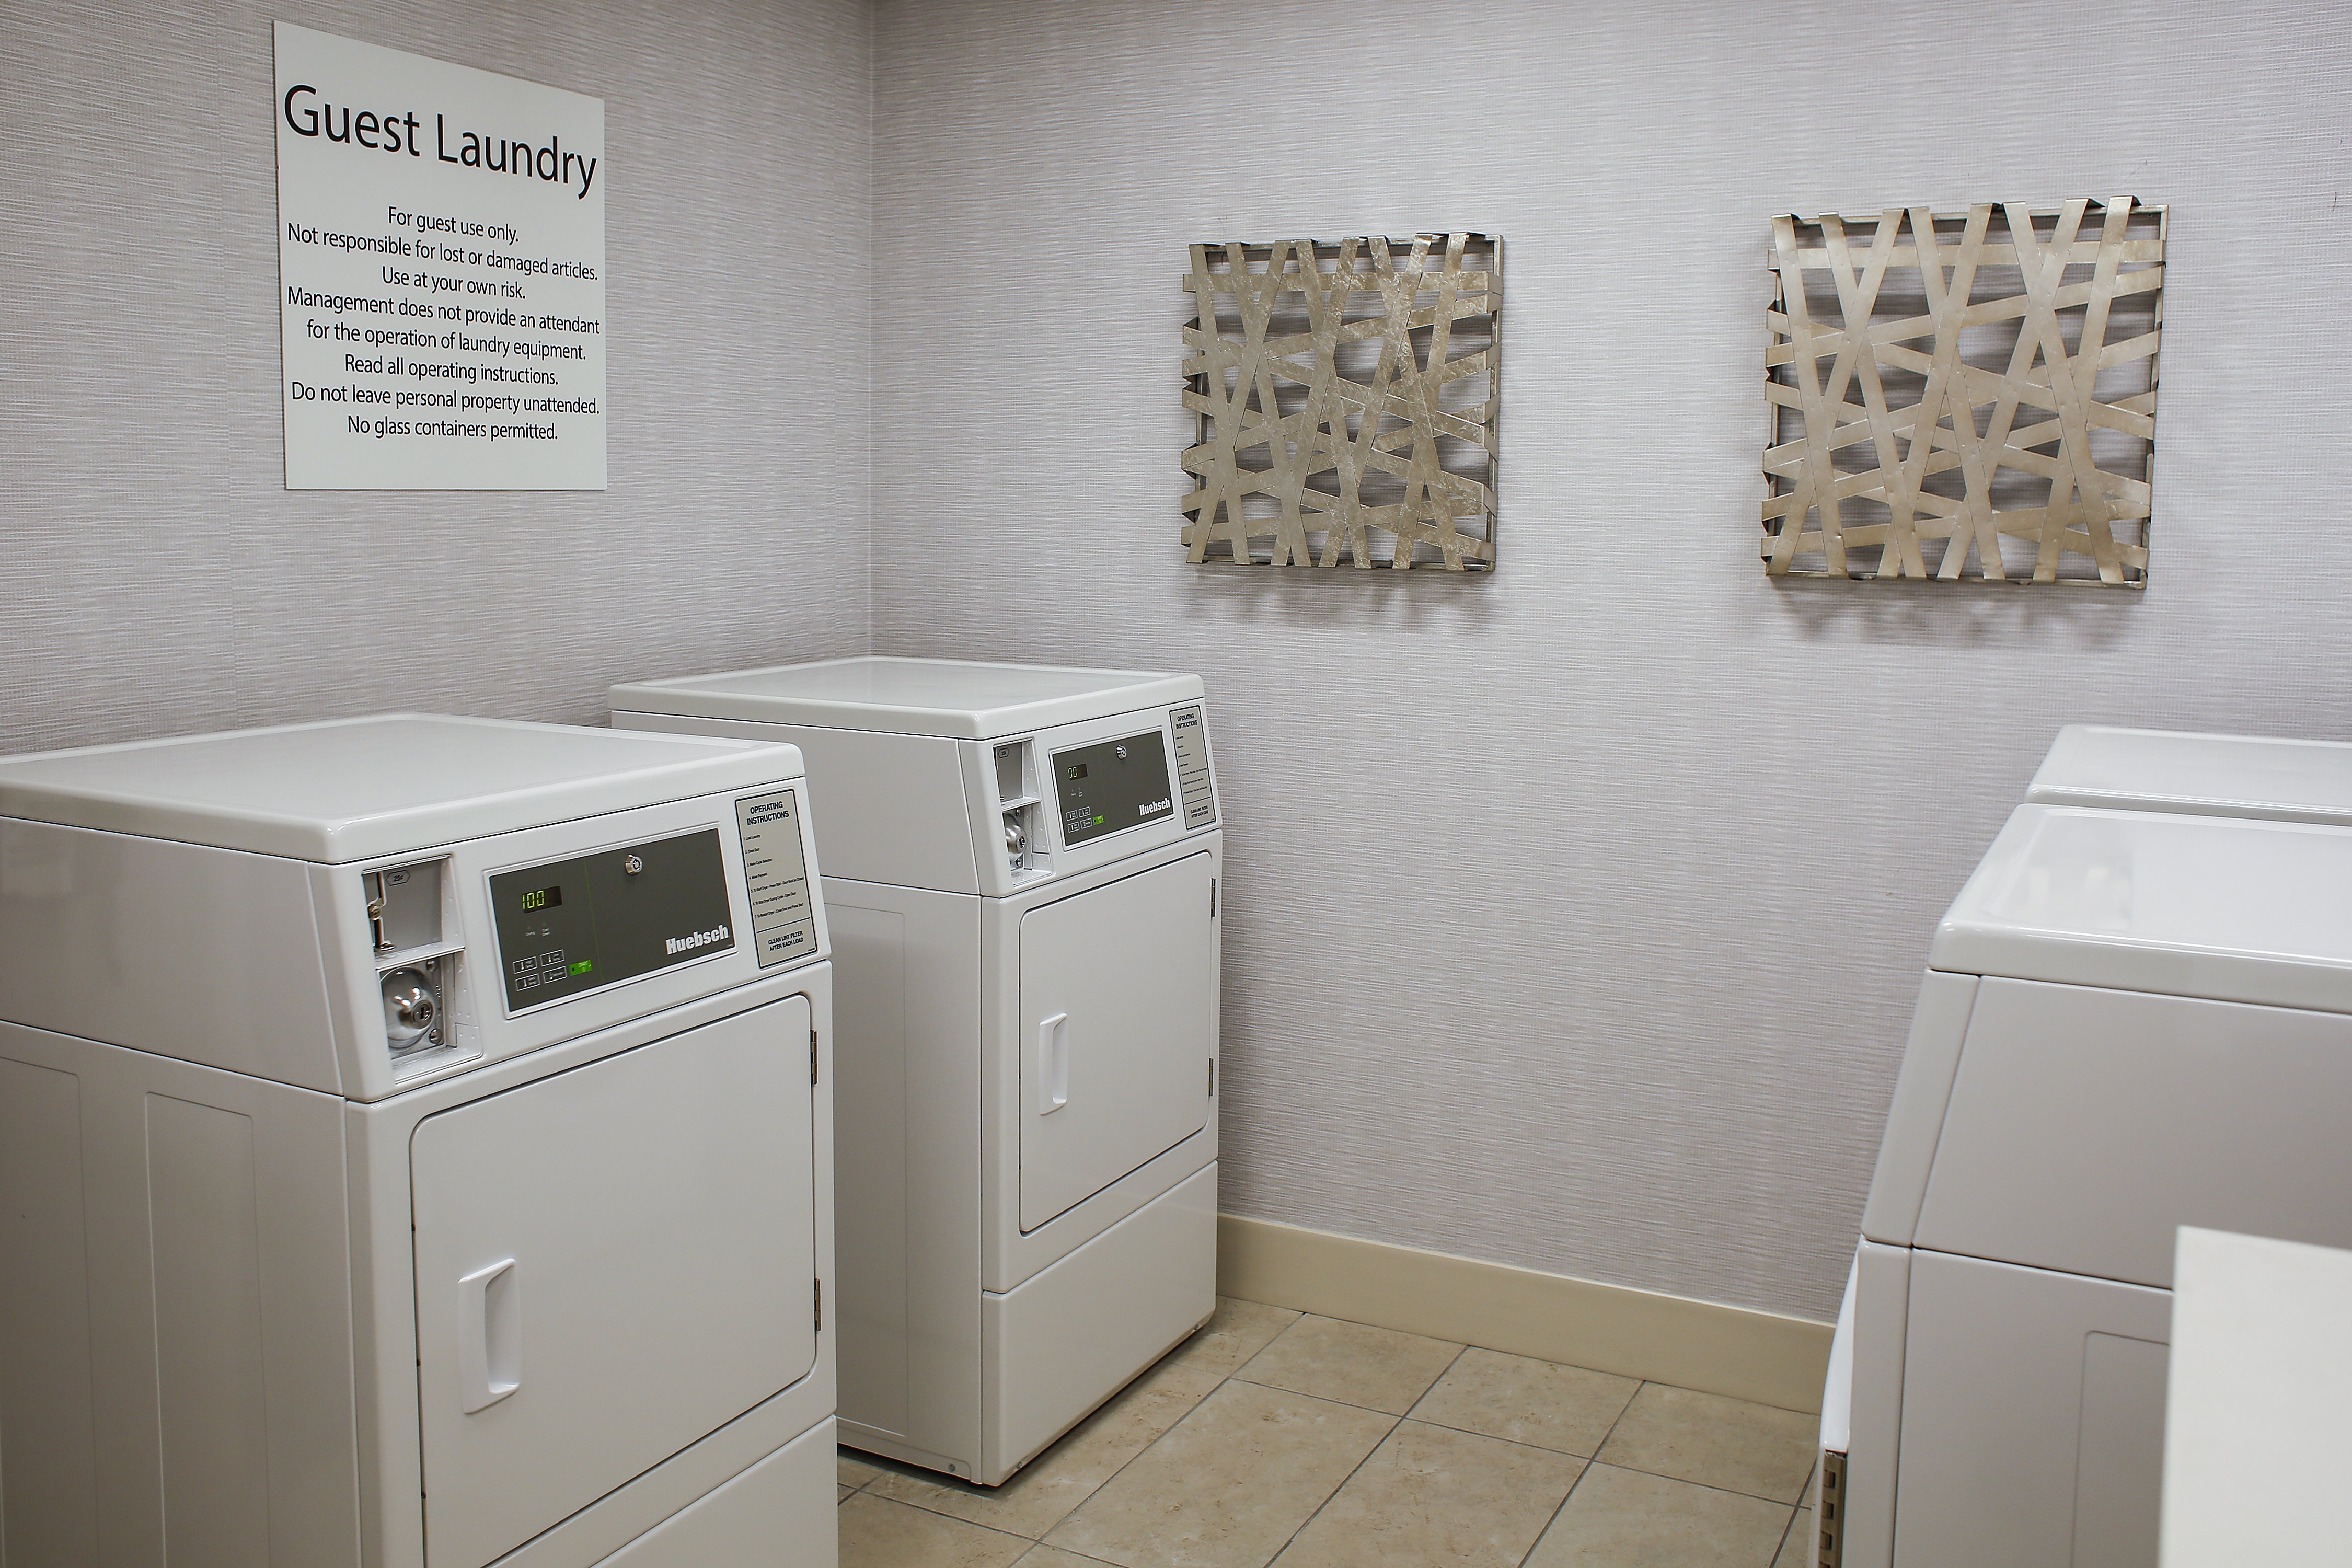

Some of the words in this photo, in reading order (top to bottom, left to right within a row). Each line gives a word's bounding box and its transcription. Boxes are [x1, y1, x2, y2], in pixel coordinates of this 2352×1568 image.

[284, 84, 420, 157] Guest
[437, 113, 597, 200] Laundry
[388, 206, 413, 226] For
[417, 215, 456, 233] guest
[460, 221, 484, 237] use
[488, 223, 518, 246] only.
[288, 222, 319, 245] Not
[323, 232, 411, 256] responsible
[414, 239, 436, 259] for
[440, 242, 465, 263] lost
[468, 252, 483, 266] or
[486, 249, 548, 276] damaged
[552, 261, 598, 281] articles.
[382, 266, 410, 286] Use
[413, 272, 428, 289] at
[431, 276, 464, 294] your
[467, 281, 497, 296] own
[501, 281, 526, 299] risk.
[288, 286, 395, 315] Management
[398, 297, 433, 318] does
[438, 305, 462, 321] not
[466, 308, 516, 326] provide
[520, 315, 535, 328] an
[539, 315, 600, 335] attendant
[306, 319, 330, 339] for
[333, 321, 360, 342] the
[365, 329, 436, 348] operation
[441, 331, 456, 349] of
[459, 332, 510, 358] laundry
[513, 340, 586, 361] equipment.
[345, 353, 383, 374] Read
[388, 356, 403, 375] all
[408, 362, 476, 384] operating
[481, 363, 558, 385] instructions.
[292, 381, 316, 400] Do
[320, 386, 348, 402] not
[352, 384, 391, 404] leave
[396, 389, 457, 409] personal
[462, 395, 520, 415] property
[524, 397, 599, 414] unattended.
[348, 415, 370, 433] No
[374, 416, 410, 439] glass
[414, 419, 487, 437] containers
[491, 422, 558, 442] permitted.
[1176, 720, 1197, 729] INSTRUCTIONS
[747, 811, 789, 825] INSTRUCTIONS
[750, 801, 783, 814] OPERATING
[1139, 798, 1171, 816] Huebsch
[523, 891, 545, 910] 100
[665, 924, 729, 955] Huebsch
